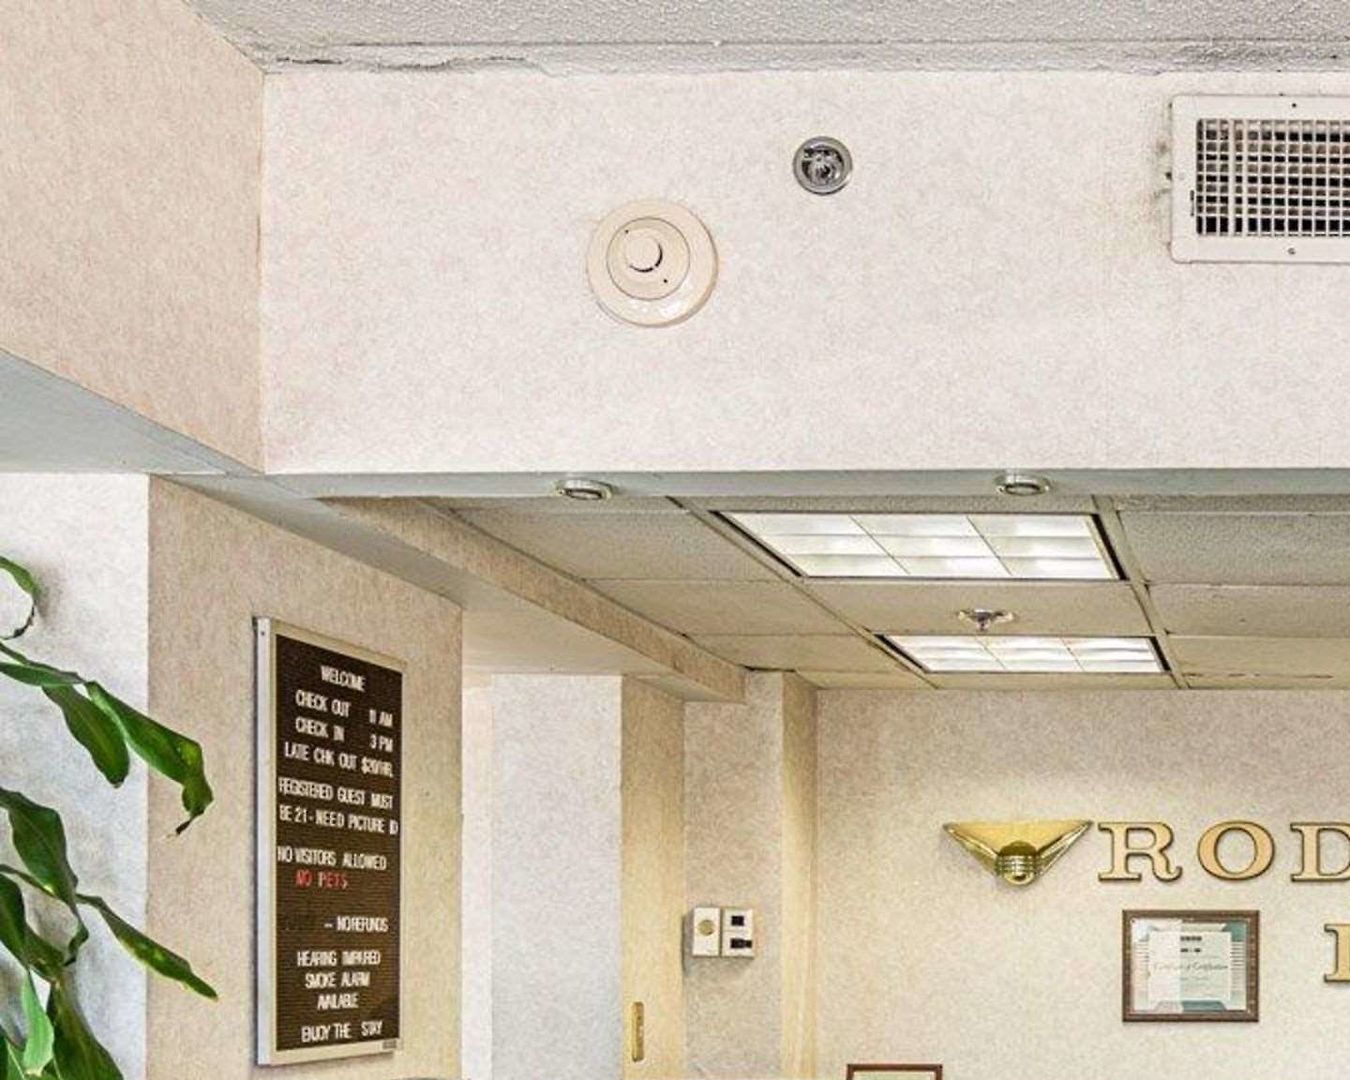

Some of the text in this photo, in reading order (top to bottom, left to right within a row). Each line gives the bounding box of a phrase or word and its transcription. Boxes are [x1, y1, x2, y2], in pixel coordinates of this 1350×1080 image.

[321, 666, 366, 692] WELCOME
[295, 690, 328, 712] CHECK
[331, 699, 351, 717] OUT
[379, 712, 393, 727] AM
[295, 717, 393, 752] CHECK IN 3 PM
[284, 741, 310, 760] LATE
[313, 748, 335, 765] CHK
[339, 753, 357, 770] OUT
[279, 777, 393, 808] REGISTERED GUEST MUST
[279, 805, 292, 820] BE
[295, 807, 307, 822] 21
[315, 809, 345, 827] NEED
[348, 814, 385, 833] PICTURE
[389, 820, 398, 835] ID
[277, 846, 386, 870] NO VISITORS ALLOWED
[295, 870, 348, 889] NO PETS
[297, 951, 381, 966] HEARING IMPAIRED
[305, 972, 370, 989] SMOKE ALARM
[317, 993, 359, 1010] AVAILABLE
[301, 1021, 383, 1043] ENJOY THE STAY
